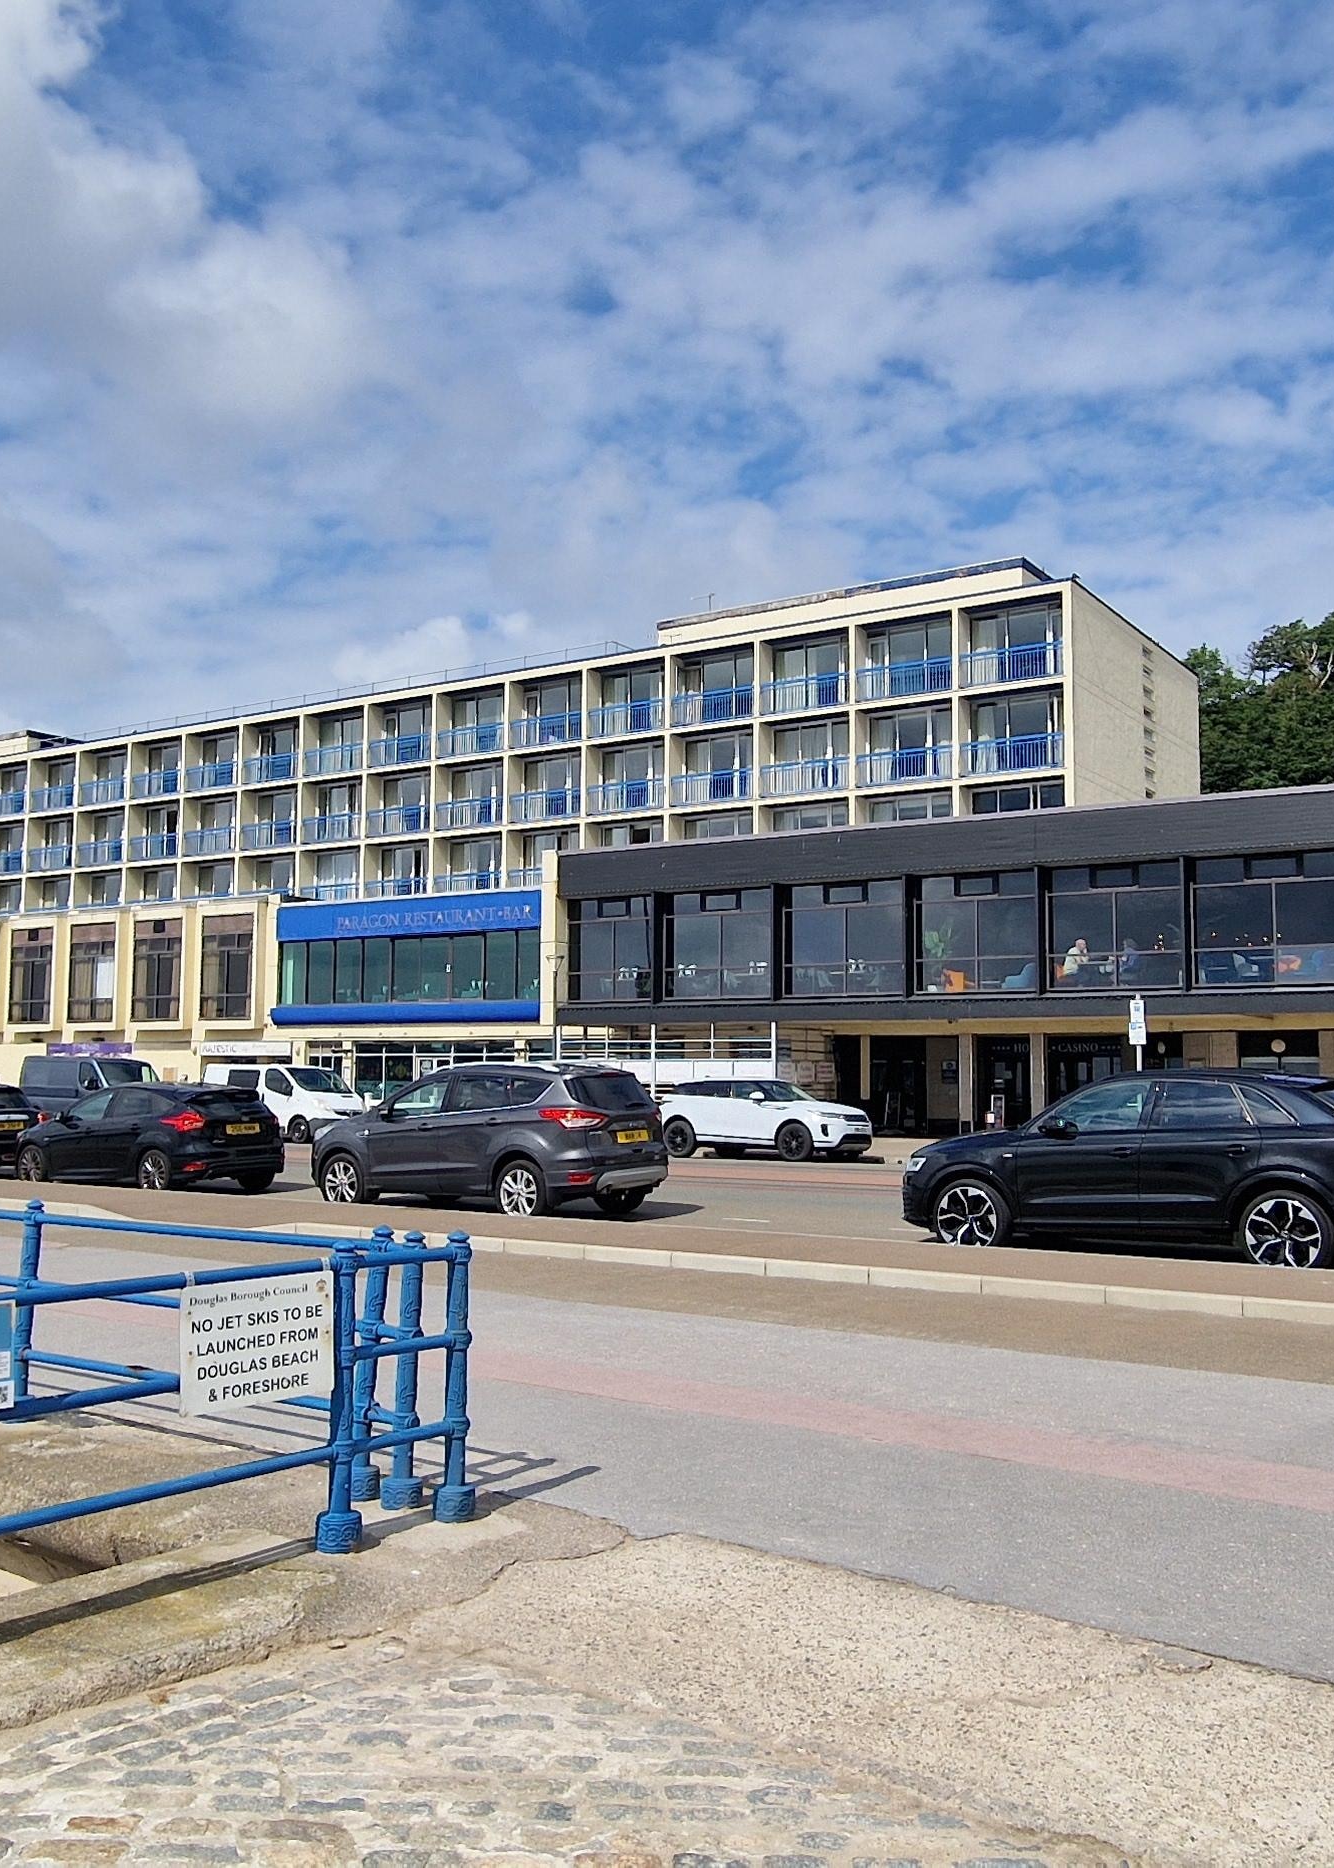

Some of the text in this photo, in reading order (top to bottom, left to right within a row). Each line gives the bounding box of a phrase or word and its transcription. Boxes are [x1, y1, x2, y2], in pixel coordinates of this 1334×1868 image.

[336, 913, 399, 931] PARAGON
[404, 906, 497, 926] RESTAURANT
[1058, 1043, 1099, 1053] CASINO
[189, 1283, 308, 1309] Douglas Borough Council
[191, 1304, 323, 1334] NO JET SKIS TO BE
[197, 1327, 318, 1357] LAUNCHED FROM
[197, 1349, 319, 1381] DOUGLAS BEACH
[208, 1373, 309, 1403] & FORESHORE
